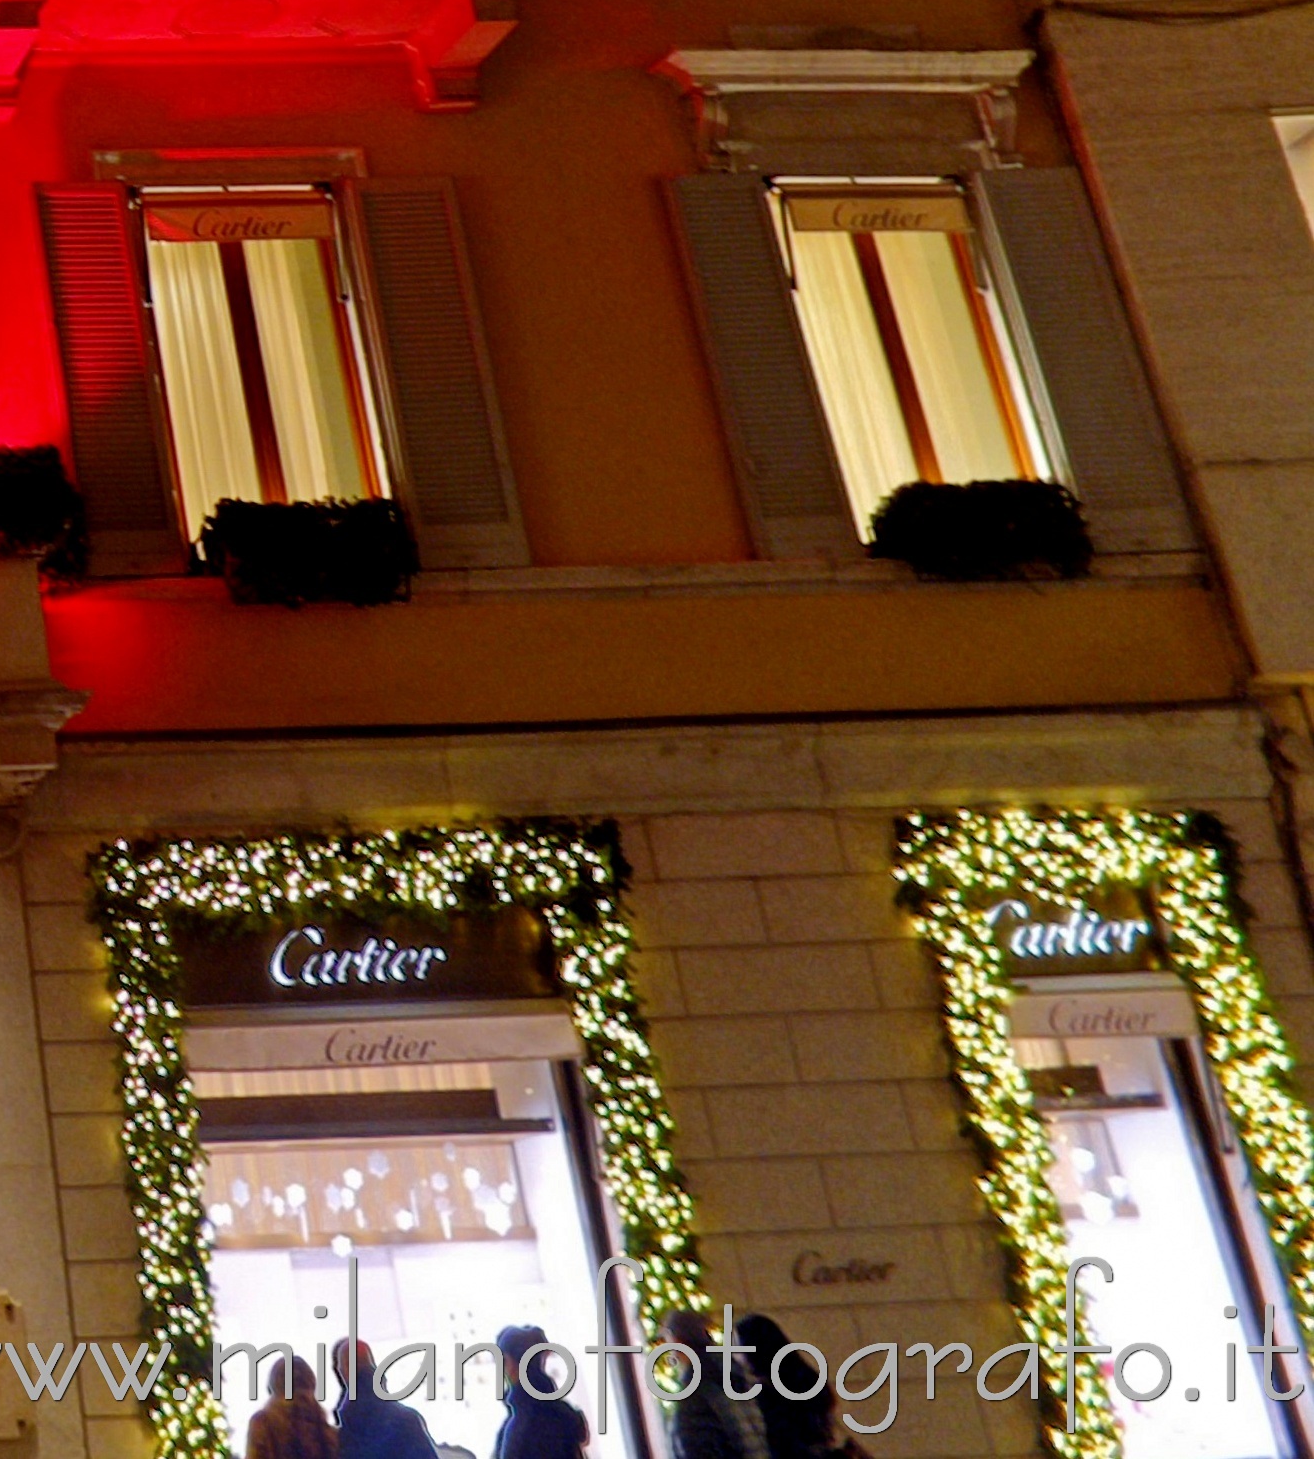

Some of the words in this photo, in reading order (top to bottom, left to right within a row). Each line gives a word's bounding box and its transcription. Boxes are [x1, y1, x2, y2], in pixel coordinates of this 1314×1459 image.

[192, 208, 292, 238] Cartier
[832, 201, 929, 229] Cartier
[270, 924, 448, 987] Cartier
[1048, 1000, 1156, 1032] Cartier
[325, 1028, 437, 1062] Cartier
[791, 1250, 895, 1285] Cartier
